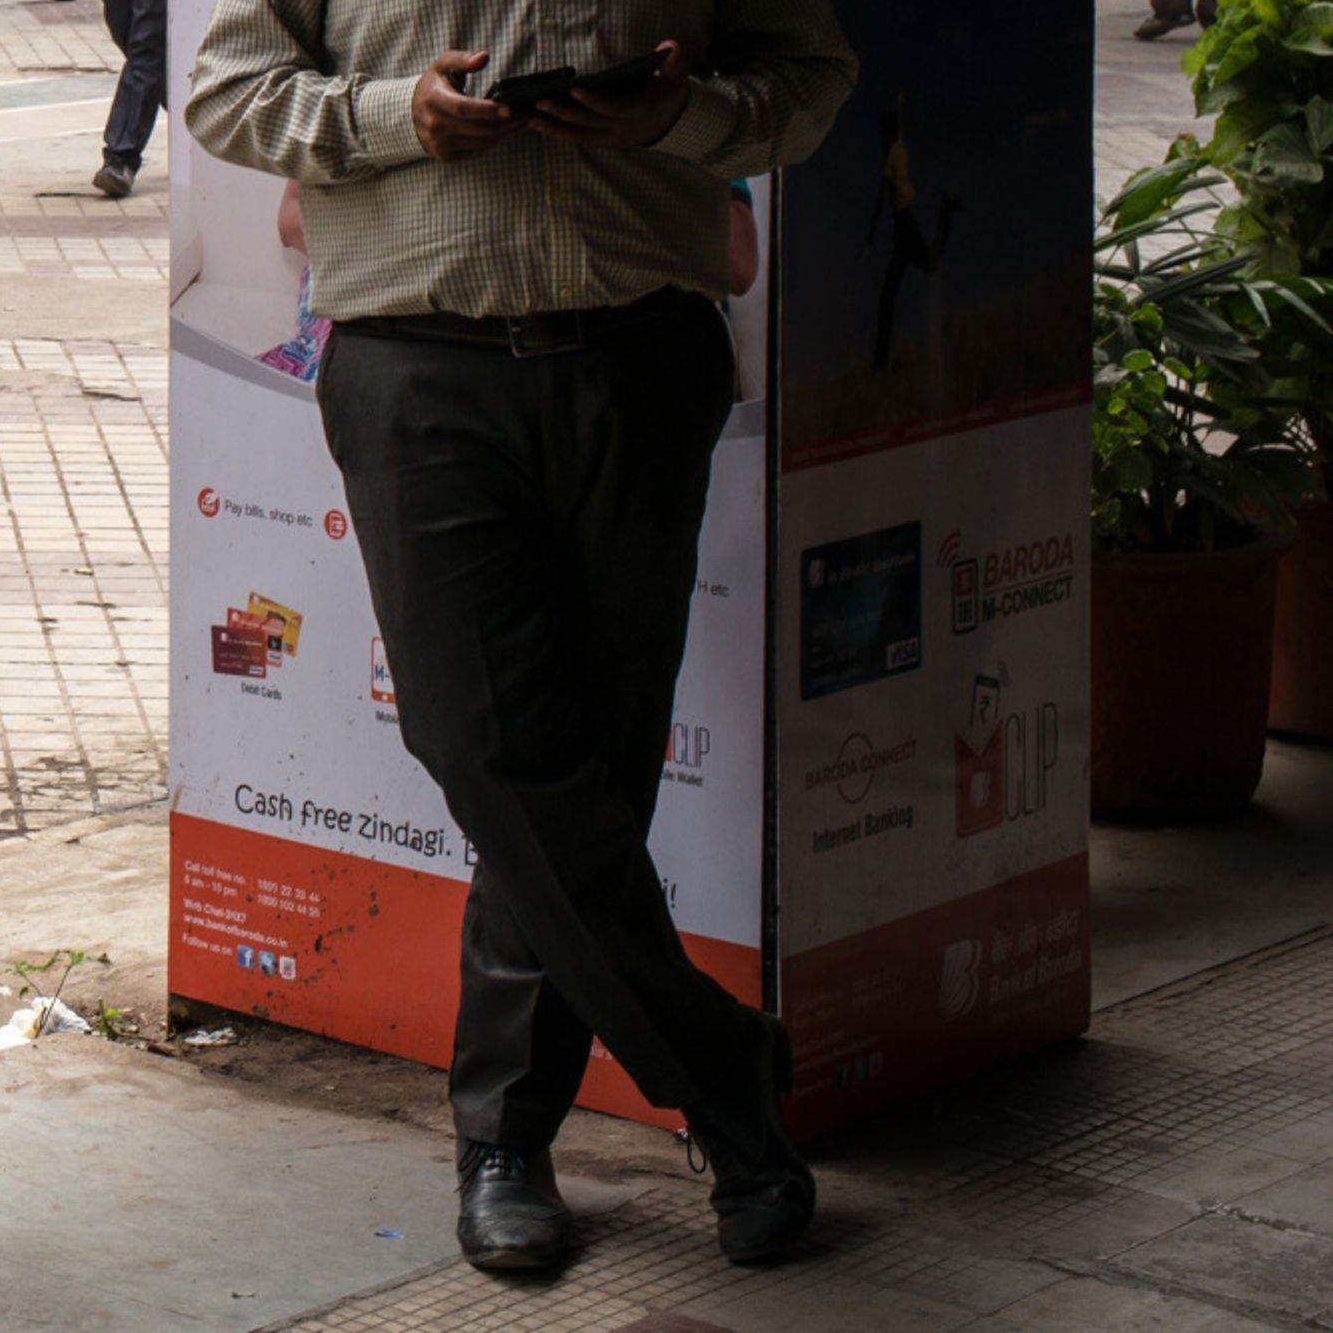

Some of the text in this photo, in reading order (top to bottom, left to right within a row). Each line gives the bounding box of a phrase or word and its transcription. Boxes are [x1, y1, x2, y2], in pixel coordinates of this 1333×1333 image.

[224, 498, 313, 528] Pay bills, shop etc
[983, 534, 1074, 589] BARODA
[711, 583, 730, 597] etc
[982, 575, 1074, 622] M-CONNECT
[241, 681, 283, 701] Debit Cards
[673, 722, 711, 768] CLIP
[805, 739, 918, 790] BARODA CONNECT
[1005, 701, 1059, 821] CLIP
[677, 770, 704, 787] Wallet
[234, 783, 454, 858] Cash free zindagi.
